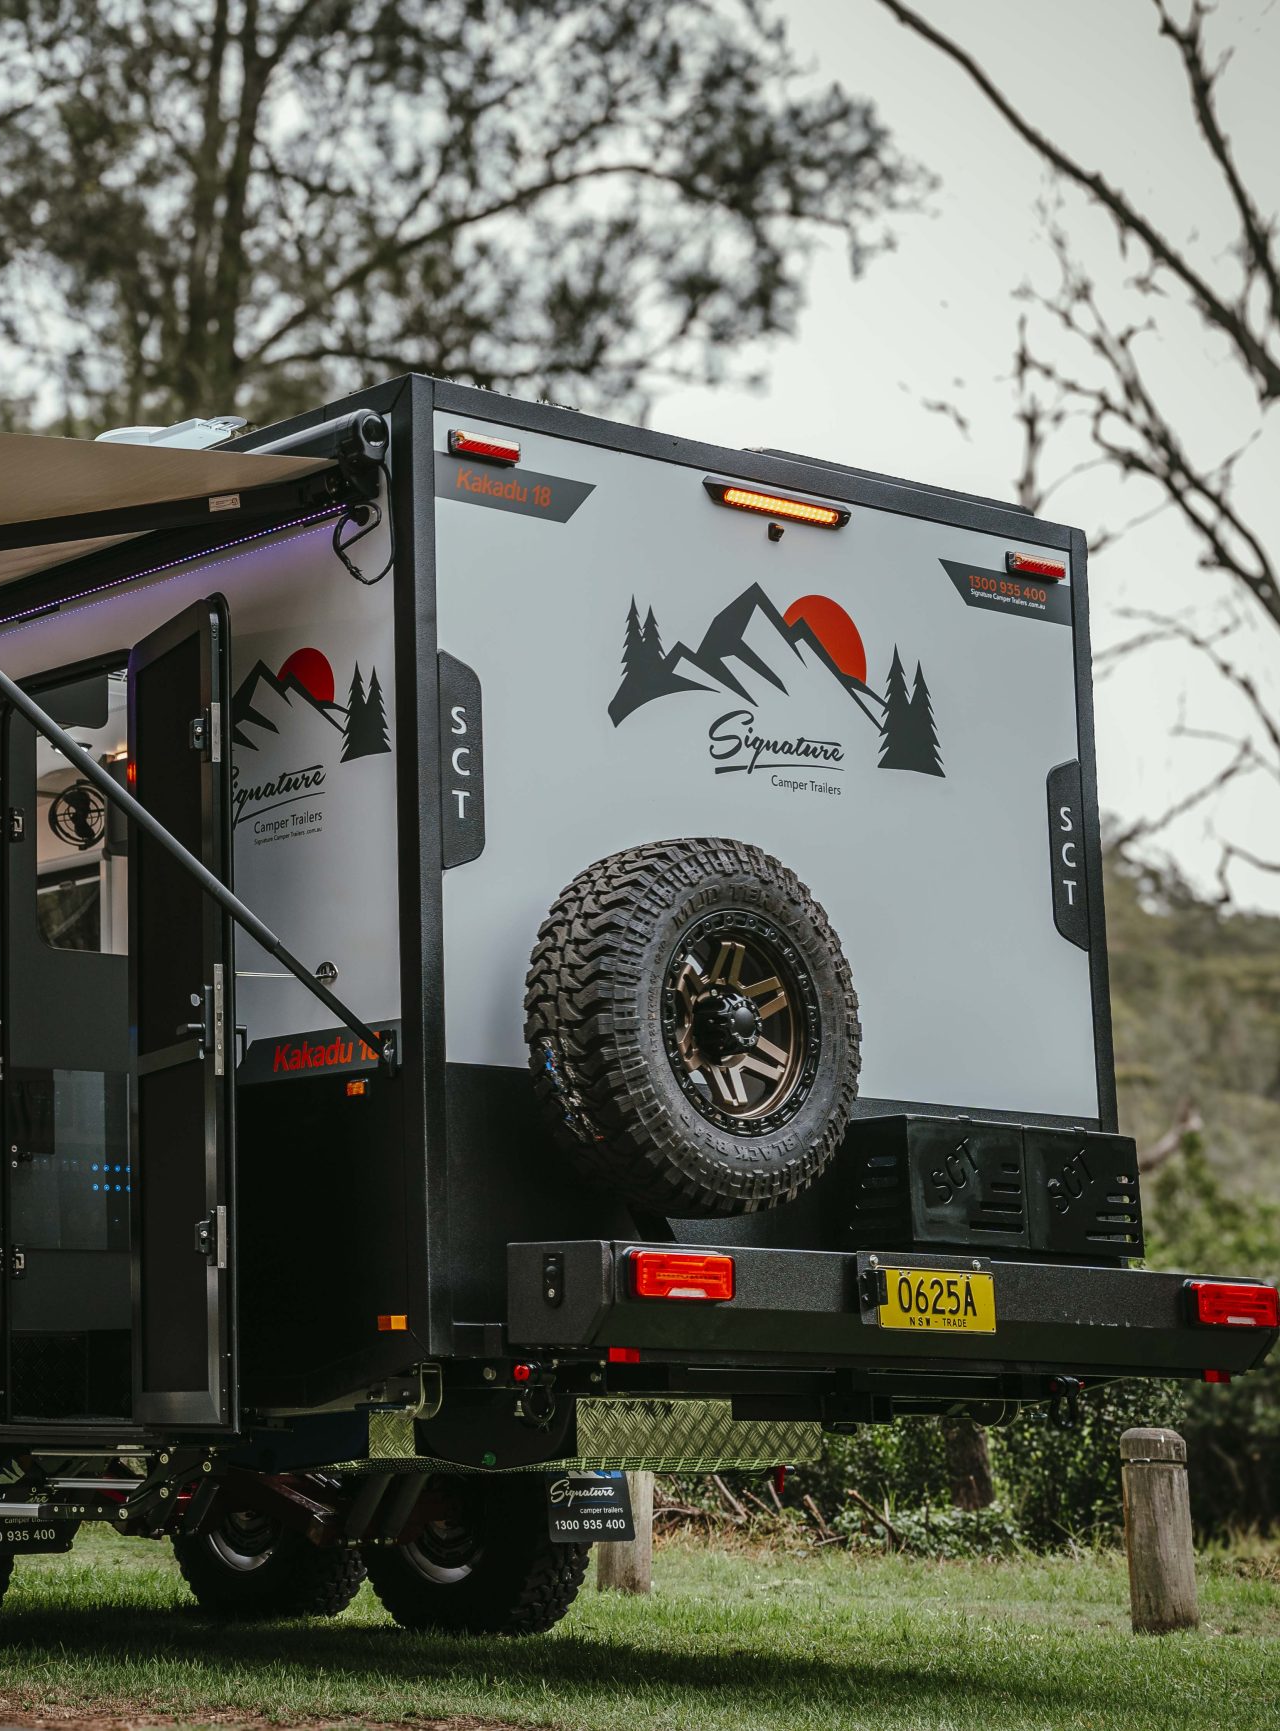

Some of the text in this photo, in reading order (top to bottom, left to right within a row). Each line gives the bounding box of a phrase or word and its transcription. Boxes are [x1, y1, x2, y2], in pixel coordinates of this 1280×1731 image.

[456, 466, 552, 508] Kakadu 18
[968, 575, 1047, 602] 1300 935 400
[708, 709, 845, 775] Signature
[771, 774, 842, 796] Camper Trailers
[254, 810, 323, 836] Camper Trailers
[273, 1035, 354, 1073] Kakadu
[931, 1135, 980, 1205] SCT
[1047, 1149, 1095, 1215] SCT
[898, 1276, 978, 1317] 0625A
[909, 1317, 931, 1327] NSW
[942, 1318, 968, 1328] TRADE
[550, 1479, 615, 1508] Signature
[7, 1530, 29, 1542] 935
[33, 1528, 56, 1540] 400
[555, 1519, 626, 1530] 1300 935 400
